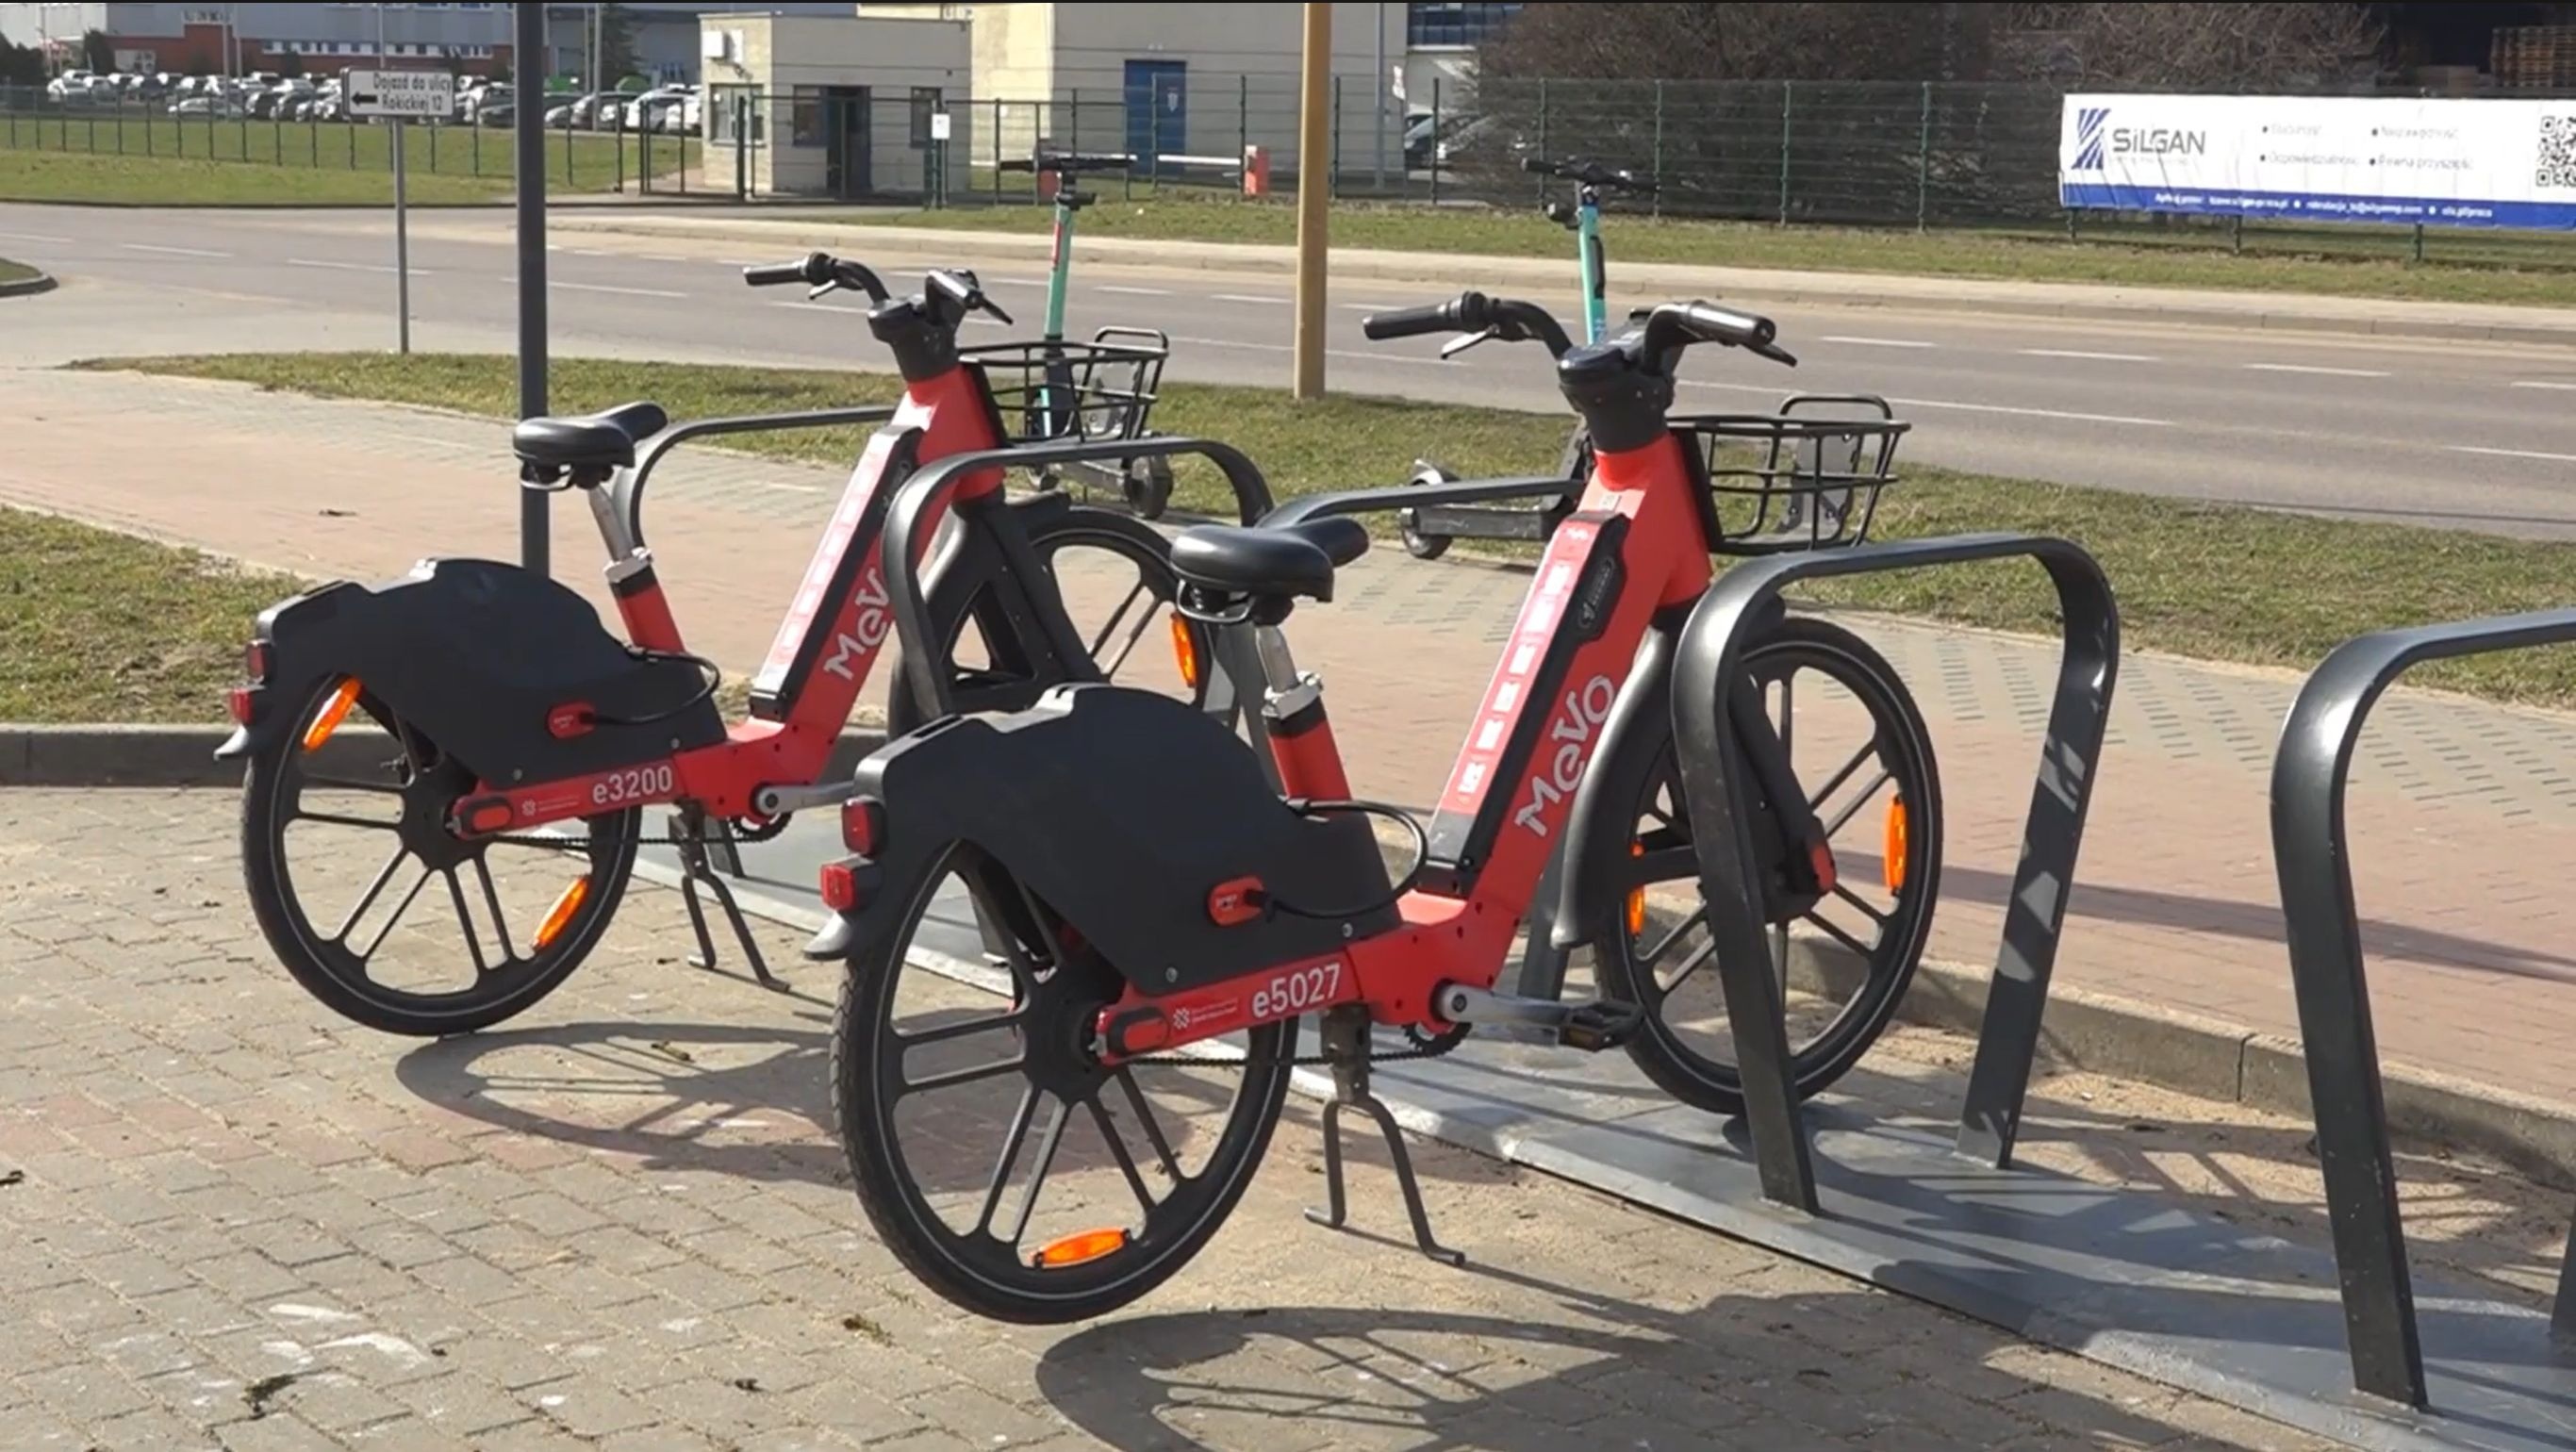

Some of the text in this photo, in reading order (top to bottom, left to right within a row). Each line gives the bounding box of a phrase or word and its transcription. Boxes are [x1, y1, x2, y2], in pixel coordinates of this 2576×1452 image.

[373, 73, 452, 95] Dojazd do ulicy
[433, 95, 441, 110] 12
[592, 766, 672, 803] e3200
[1252, 963, 1340, 1017] e5027
